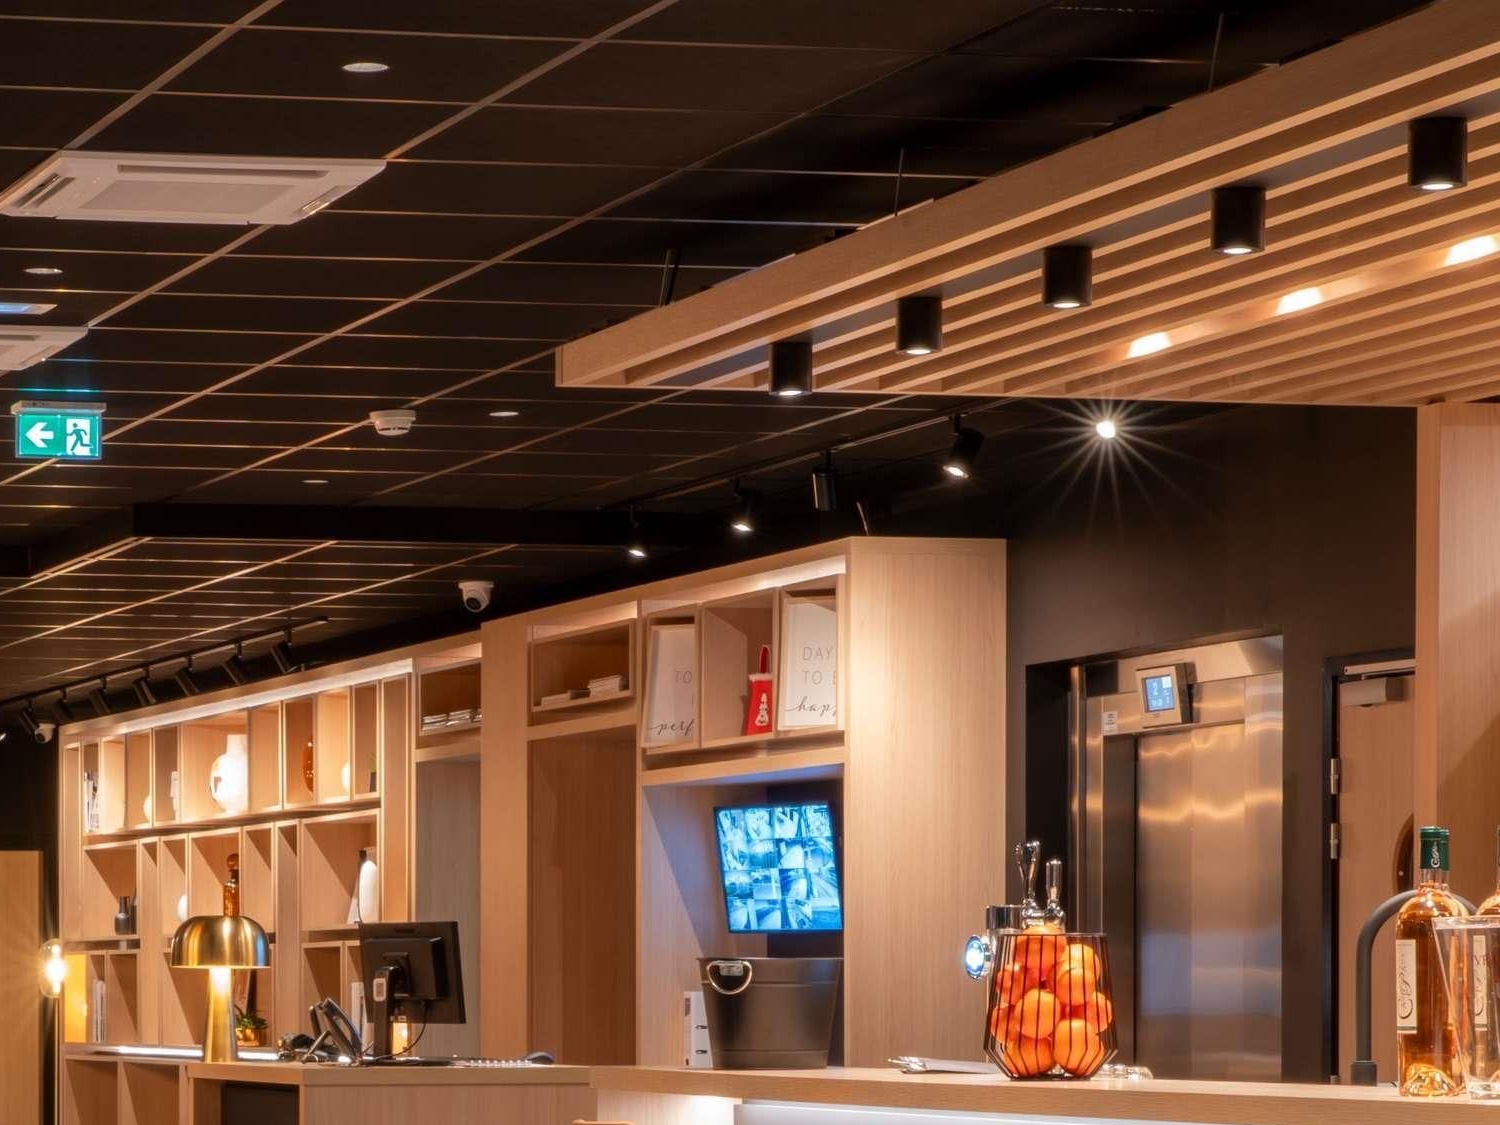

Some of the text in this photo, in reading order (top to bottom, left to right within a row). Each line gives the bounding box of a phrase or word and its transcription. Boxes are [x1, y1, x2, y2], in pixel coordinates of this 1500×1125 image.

[802, 645, 833, 661] DAY
[675, 669, 693, 684] TO
[802, 670, 822, 685] TO
